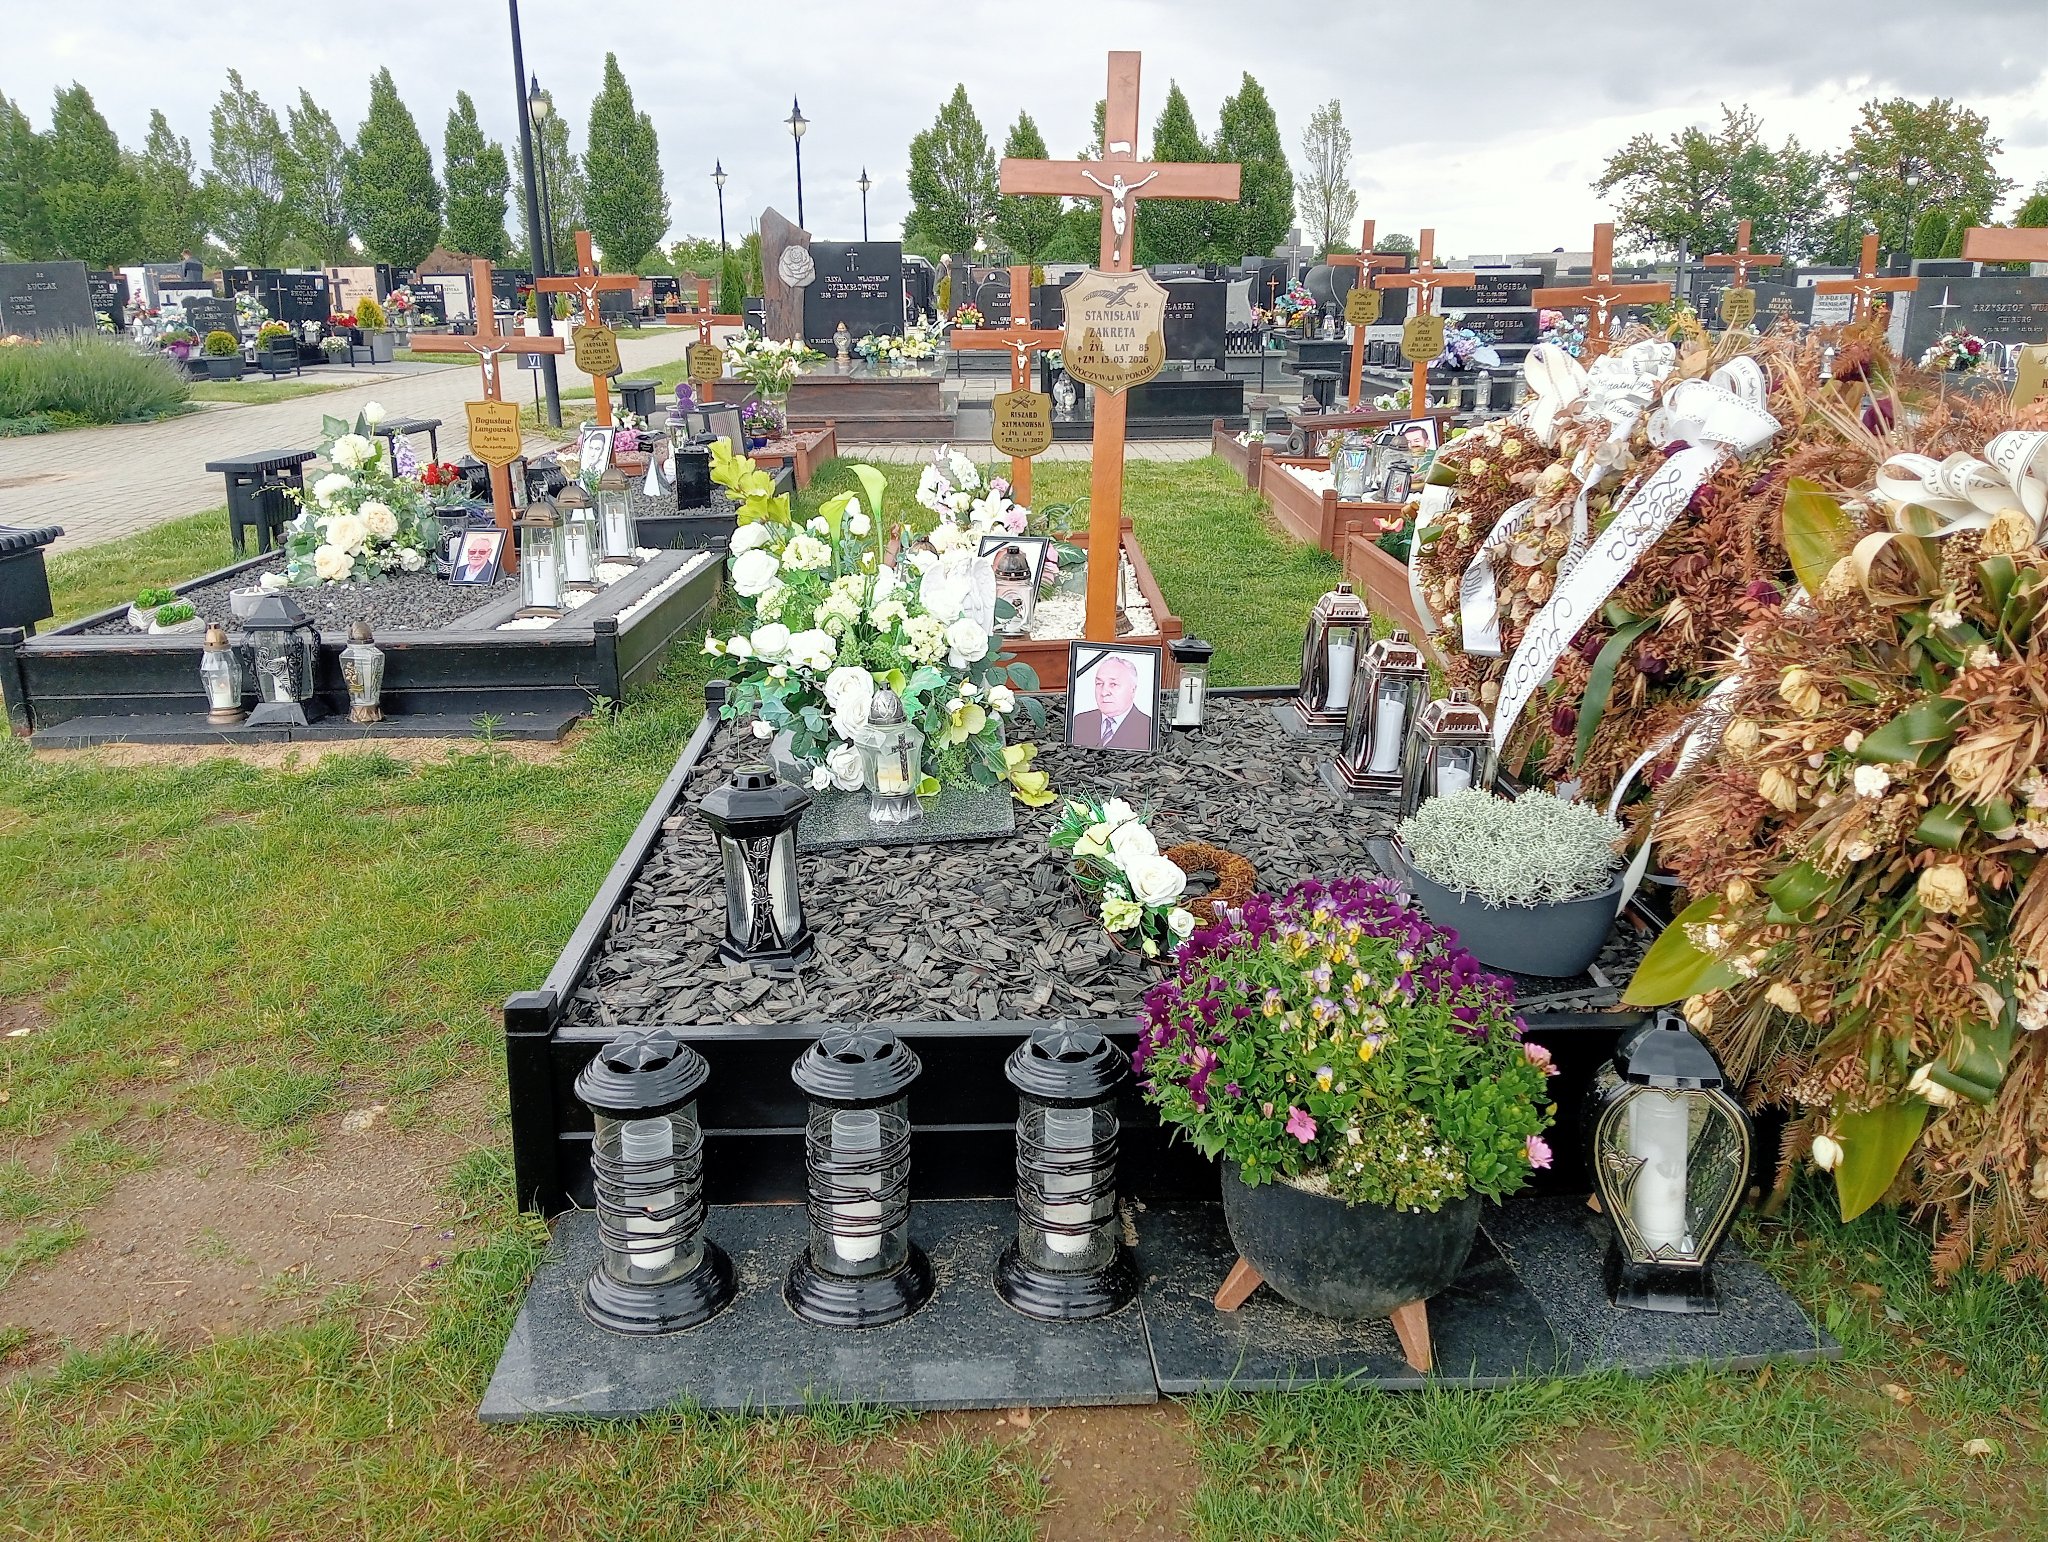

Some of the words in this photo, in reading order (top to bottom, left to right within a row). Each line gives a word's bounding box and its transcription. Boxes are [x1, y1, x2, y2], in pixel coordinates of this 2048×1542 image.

[1085, 310, 1140, 321] STANISŁAW
[1089, 327, 1135, 339] ZAKRĘTA
[1090, 340, 1104, 352] ŻYŁ
[1115, 344, 1130, 352] LAT
[1138, 344, 1149, 352] 85
[1071, 364, 1115, 381] SPOCZYWAJ
[1125, 364, 1154, 380] POKOJU
[475, 417, 512, 425] Bogusław
[1501, 597, 1572, 718] Aldona
